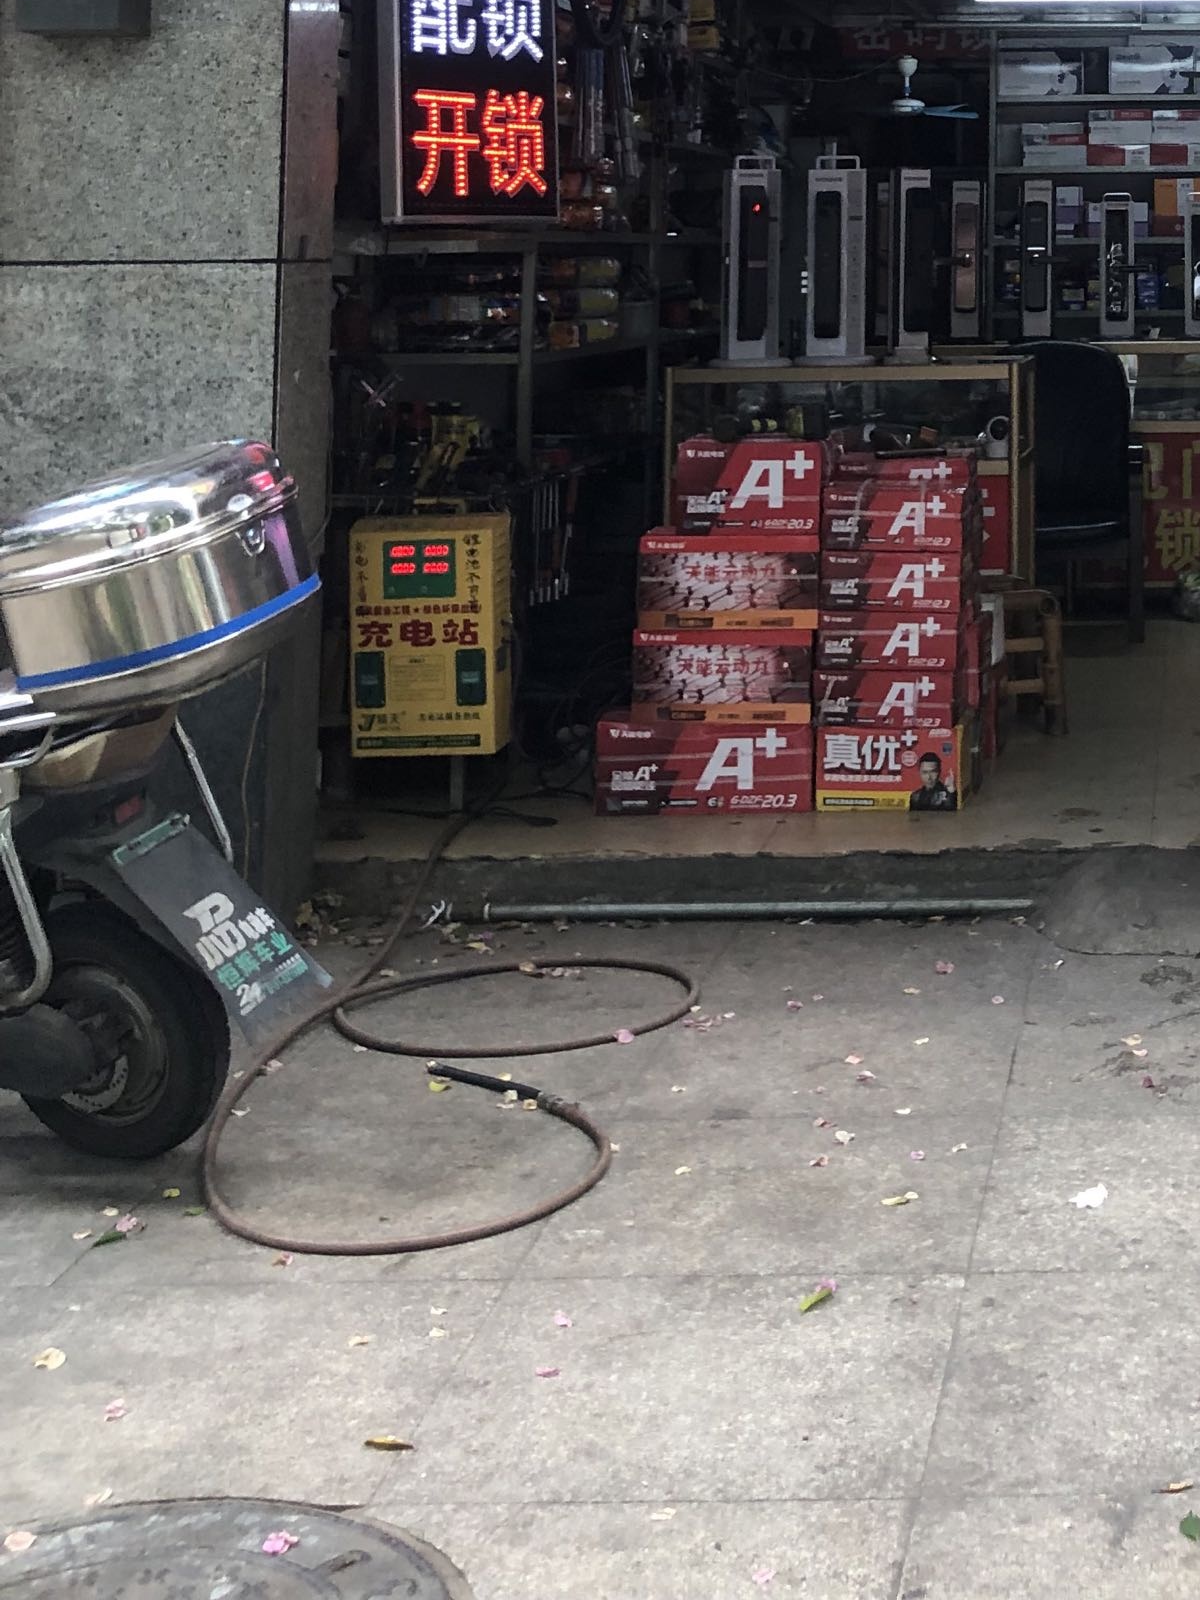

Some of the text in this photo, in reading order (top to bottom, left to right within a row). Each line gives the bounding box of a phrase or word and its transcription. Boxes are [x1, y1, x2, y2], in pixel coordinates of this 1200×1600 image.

[410, 87, 549, 197] 开锁
[358, 618, 479, 648] 充电站
